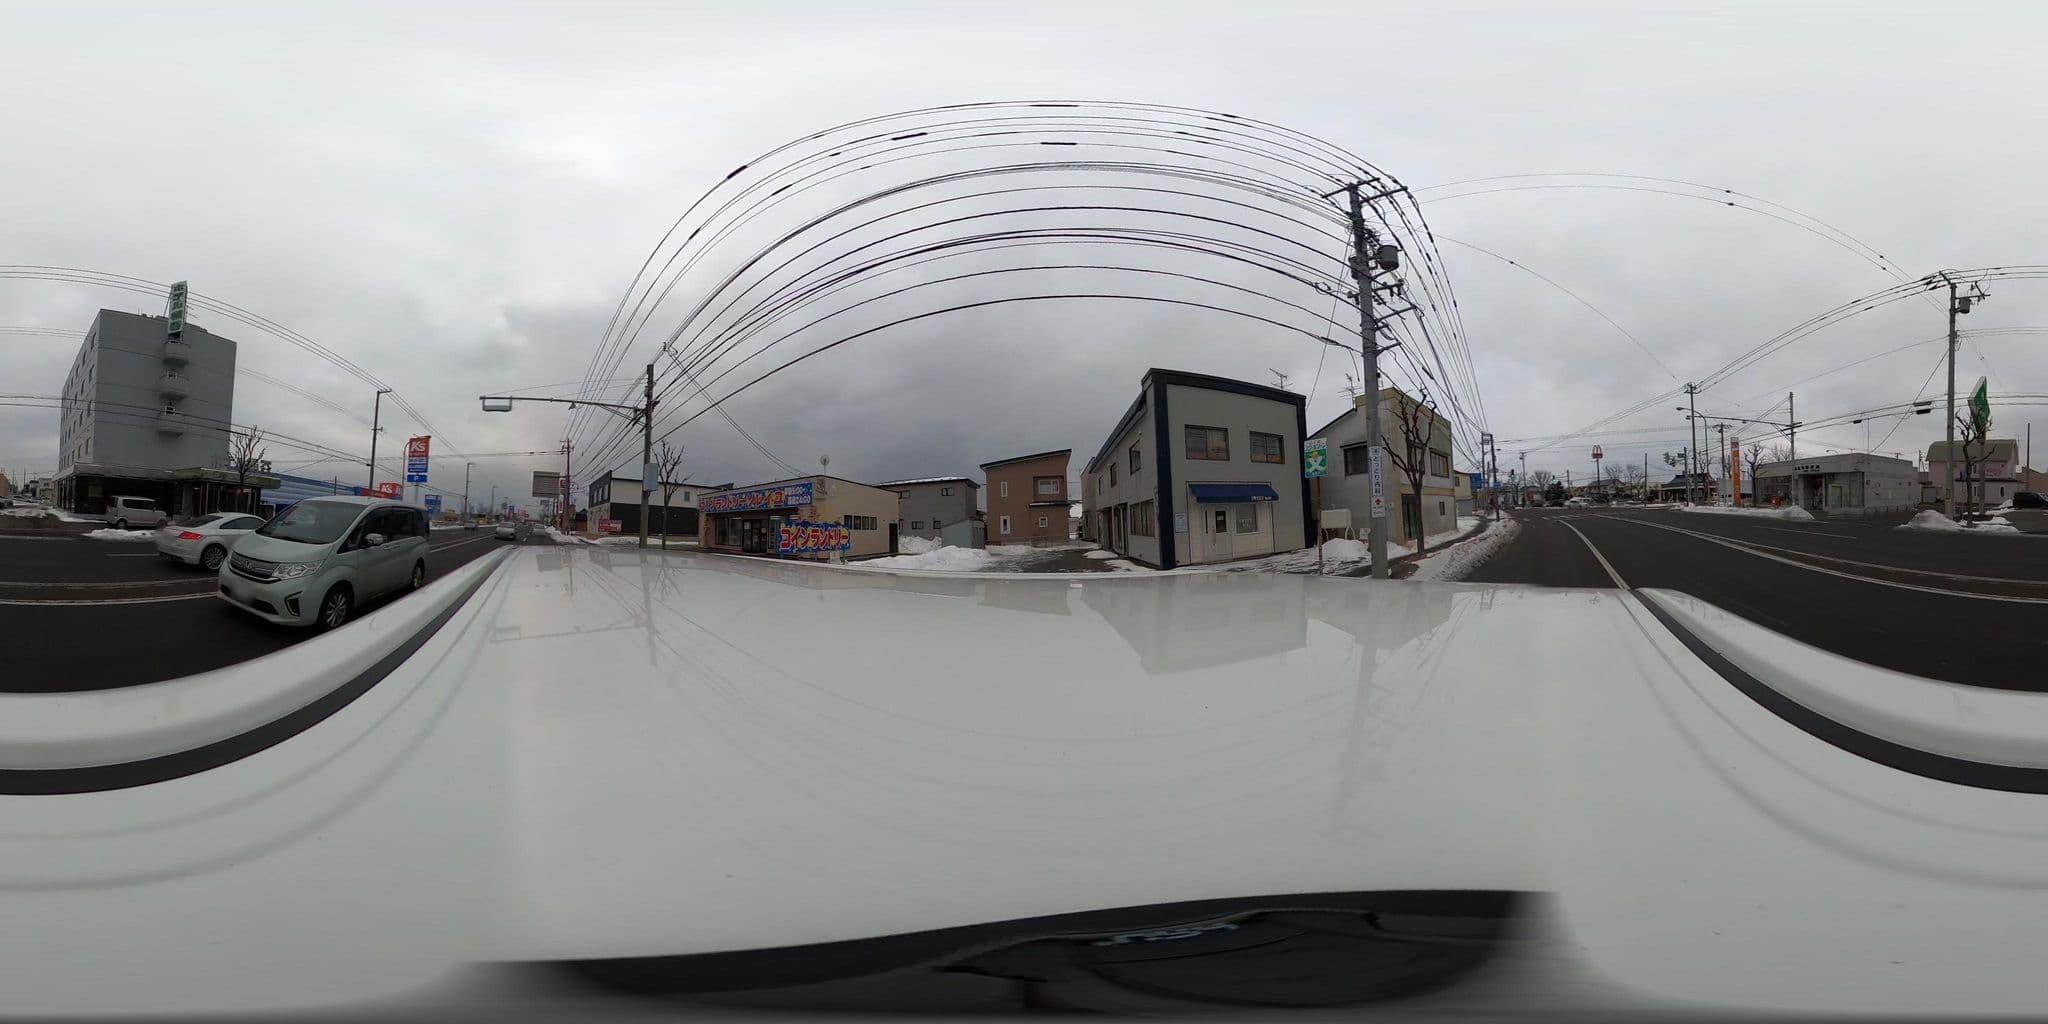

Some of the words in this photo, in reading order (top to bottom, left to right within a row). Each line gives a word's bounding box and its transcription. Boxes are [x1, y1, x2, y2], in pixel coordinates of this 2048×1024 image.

[780, 526, 849, 550] コインランドリー
